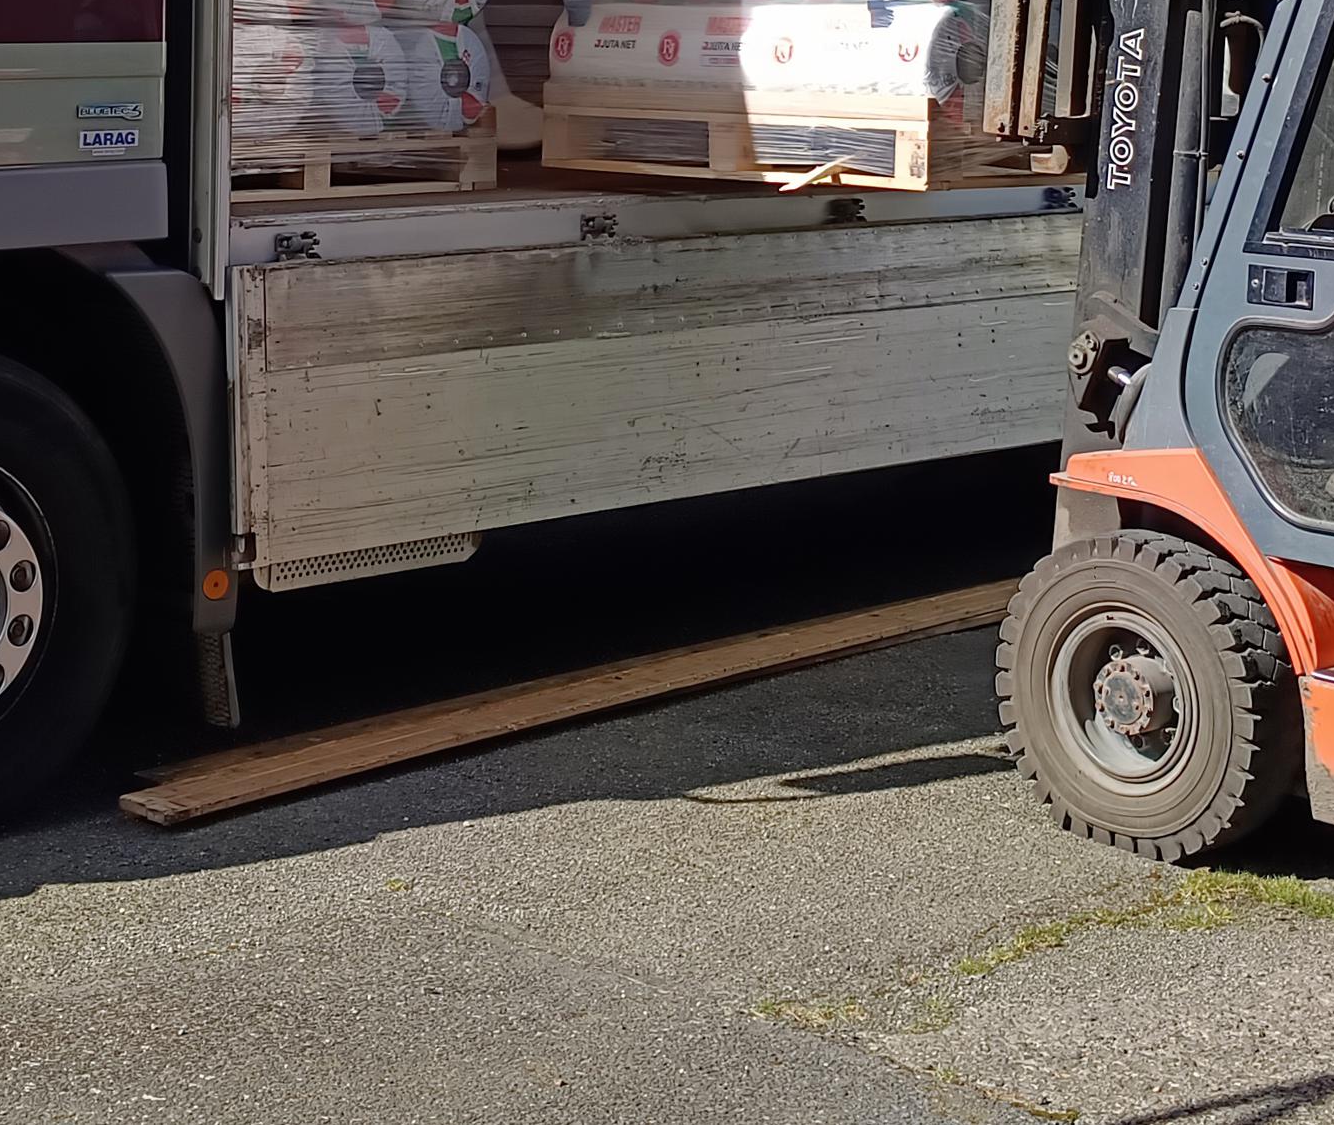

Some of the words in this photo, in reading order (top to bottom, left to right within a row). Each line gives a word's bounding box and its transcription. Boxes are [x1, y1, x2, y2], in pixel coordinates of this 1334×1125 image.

[603, 39, 619, 49] JUTA
[621, 39, 636, 50] NET
[1106, 28, 1145, 190] TOYOTA
[83, 131, 136, 147] LARAG
